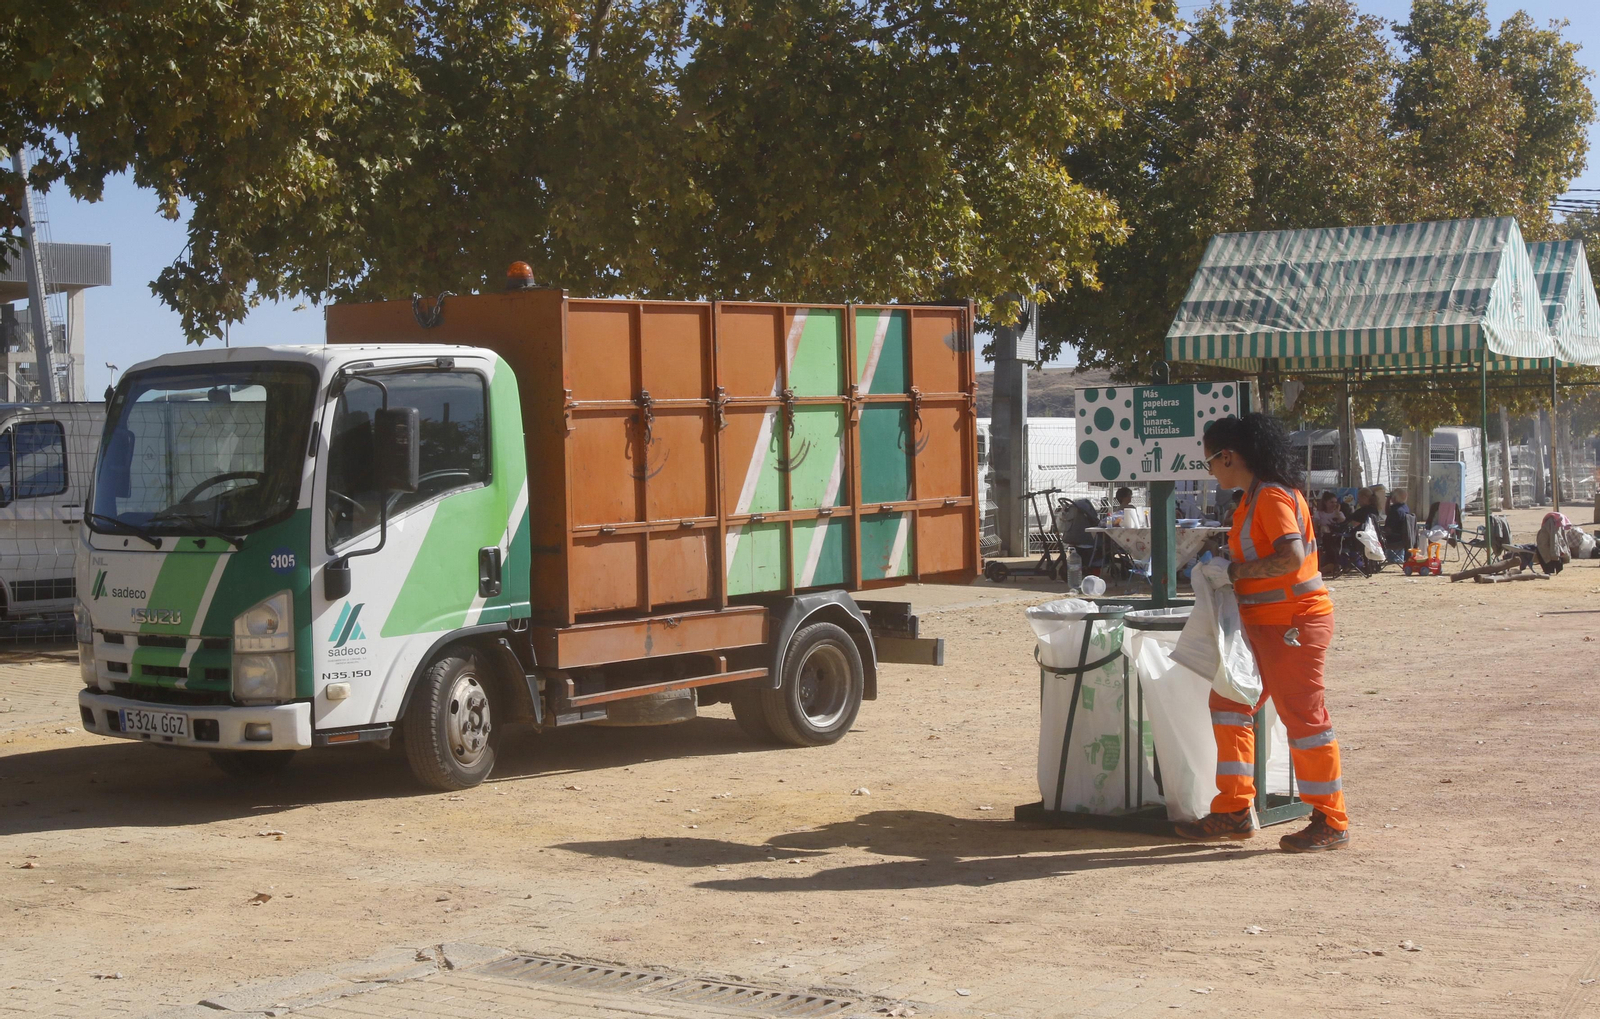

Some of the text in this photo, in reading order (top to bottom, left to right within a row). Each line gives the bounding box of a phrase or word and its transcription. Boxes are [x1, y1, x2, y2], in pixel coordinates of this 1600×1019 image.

[1142, 389, 1159, 398] Más
[1142, 398, 1180, 410] papeleras
[1142, 410, 1157, 418] que
[1143, 417, 1174, 426] lunares.
[1143, 425, 1180, 435] Utilízalas
[92, 556, 109, 566] NL
[270, 554, 296, 569] 3105
[112, 586, 147, 600] sadeco
[130, 607, 182, 626] ISUZU
[327, 646, 367, 657] sadeco
[321, 669, 372, 680] N35.150
[126, 711, 158, 733] 5324
[161, 713, 185, 735] GGZ
